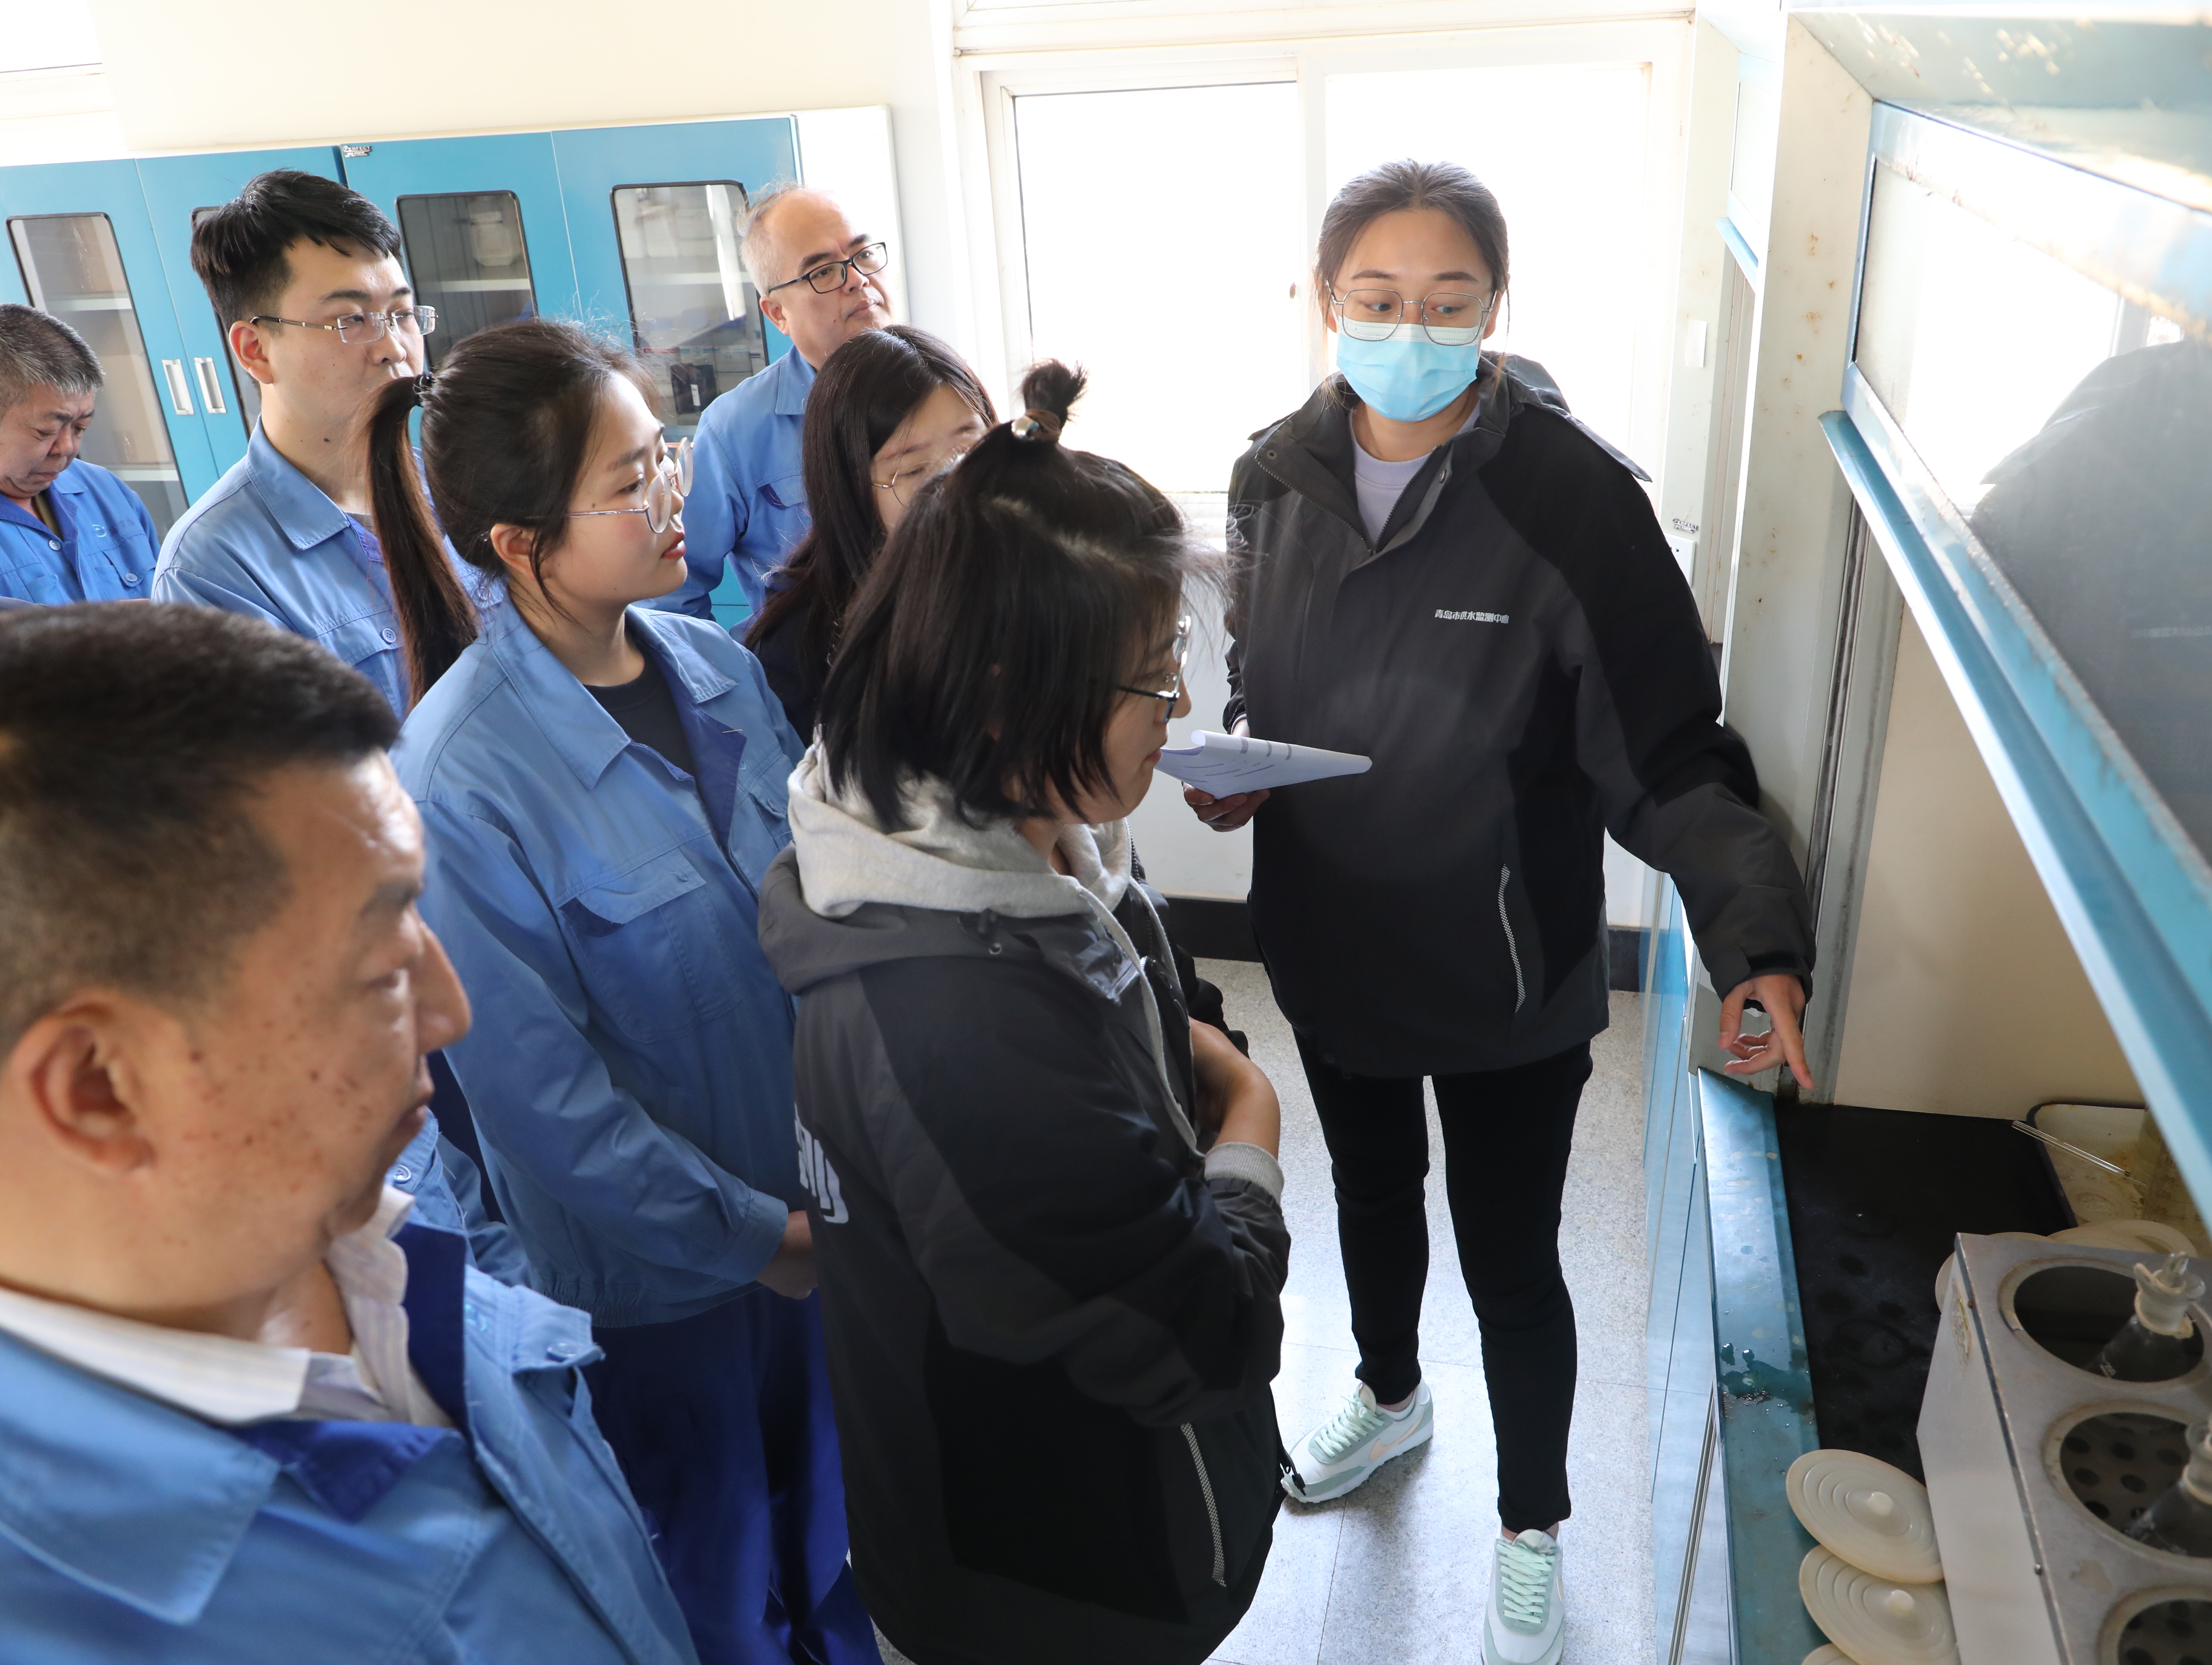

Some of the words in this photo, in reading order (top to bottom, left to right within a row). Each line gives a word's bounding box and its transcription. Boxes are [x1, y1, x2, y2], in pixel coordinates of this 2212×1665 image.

[1435, 609, 1509, 624] 青岛市供水监测中心
